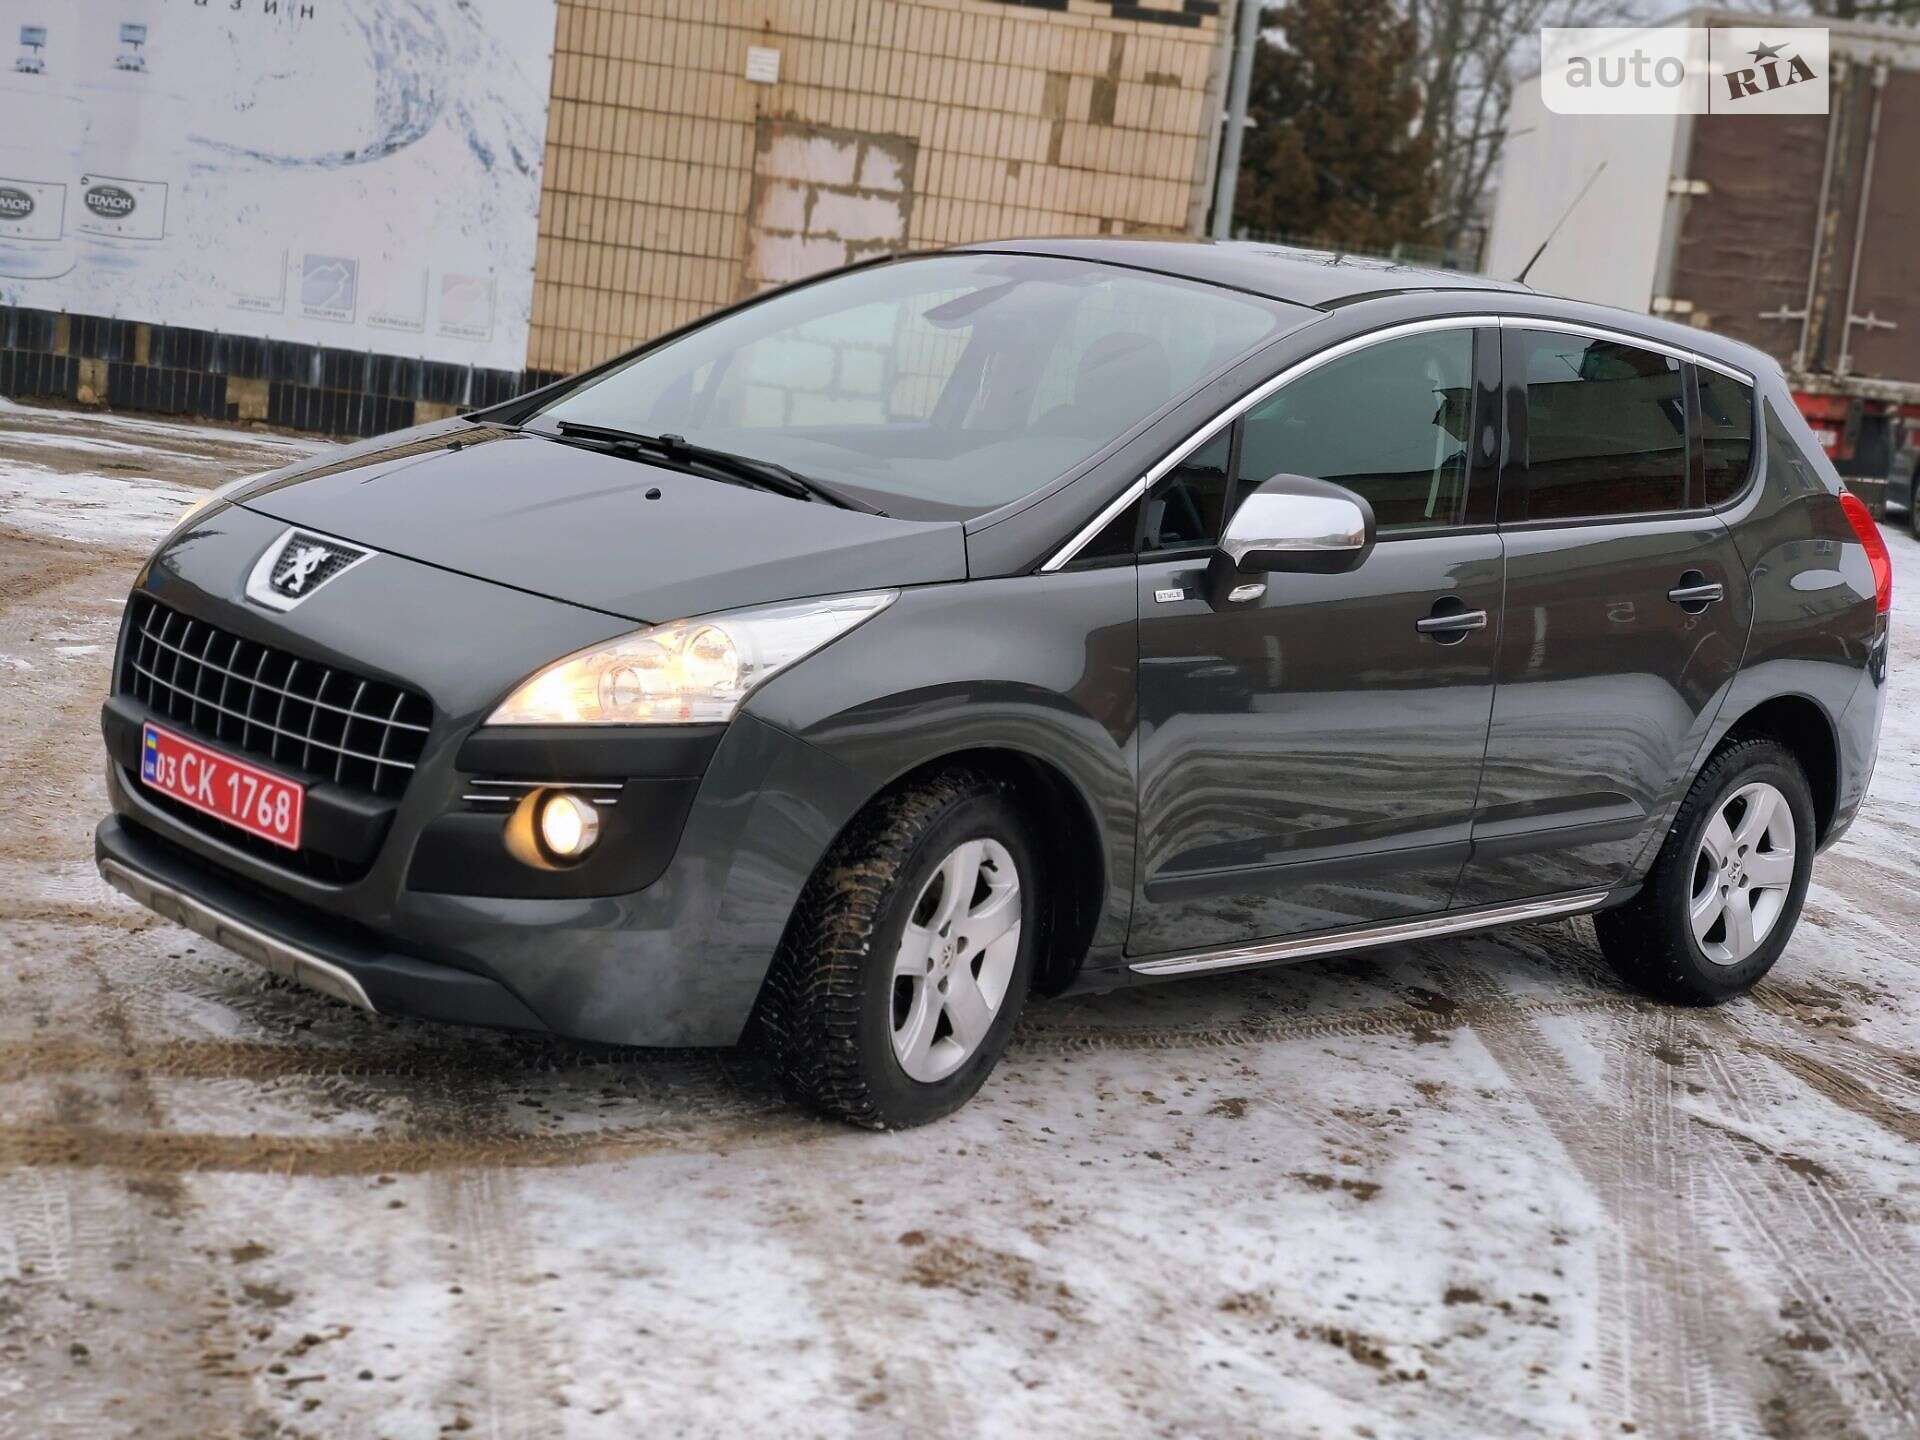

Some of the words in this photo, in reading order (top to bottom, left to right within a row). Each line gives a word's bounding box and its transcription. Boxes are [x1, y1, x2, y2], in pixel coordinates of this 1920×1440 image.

[156, 752, 176, 789] 03
[180, 752, 217, 807] CK
[227, 772, 291, 834] 1768
